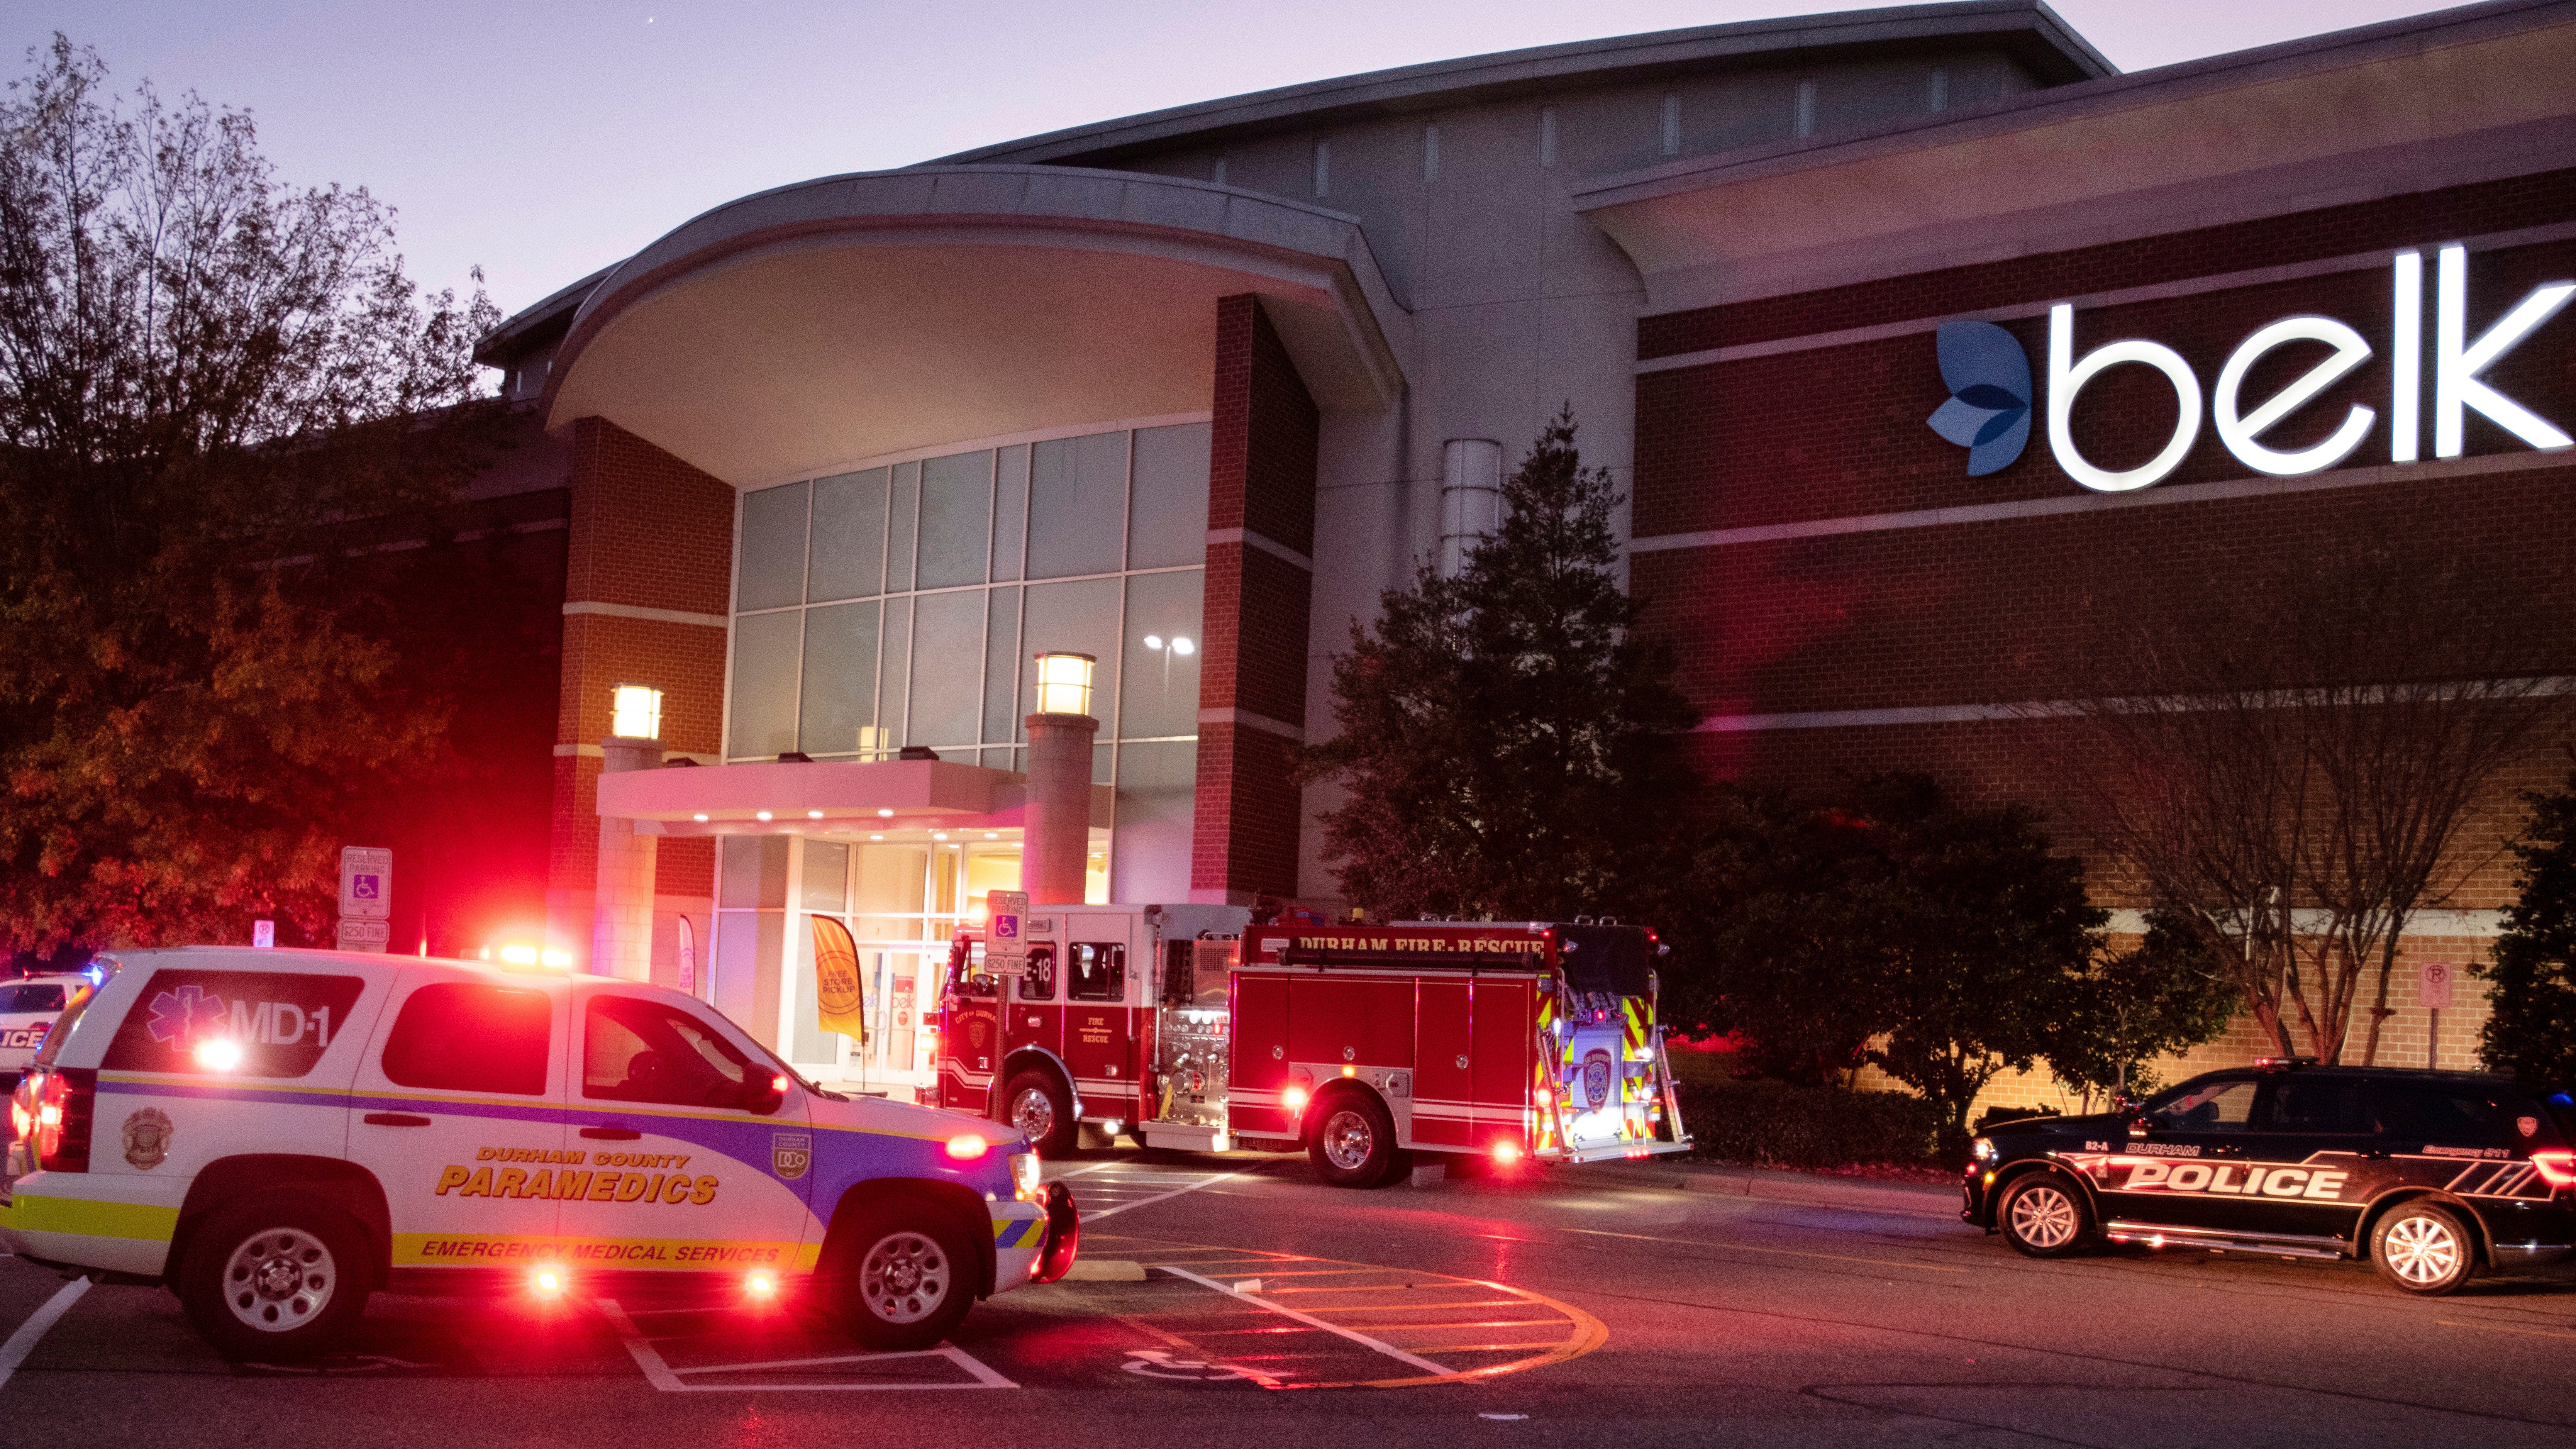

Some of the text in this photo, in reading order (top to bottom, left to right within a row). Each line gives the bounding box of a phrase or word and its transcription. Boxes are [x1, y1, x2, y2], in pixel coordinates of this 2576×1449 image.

[2049, 244, 2576, 492] belk
[347, 854, 388, 864] RESERVED
[349, 863, 385, 874] PARKING
[990, 896, 1026, 906] RESERVED
[992, 905, 1023, 915] PARKING
[344, 926, 385, 938] $250 FINE
[987, 958, 1023, 970] $250 FINE
[1023, 958, 1051, 982] E-18
[824, 977, 852, 986] STORE
[822, 985, 855, 994] PICKUP
[863, 993, 877, 1008] elk
[891, 993, 915, 1009] belk
[231, 1000, 329, 1047] MD-1
[955, 1012, 968, 1024] CITY
[976, 1010, 997, 1024] DURHA
[1088, 1017, 1104, 1025] FIRE
[0, 1031, 45, 1047] ICE
[1083, 1035, 1109, 1043] RESCUE
[2125, 1142, 2201, 1157] DURHAM
[2422, 1145, 2484, 1158] Emergency
[476, 1147, 691, 1169] DURHAM COUNTY
[435, 1165, 719, 1205] PARAMEDICS
[2123, 1163, 2348, 1199] POLICE
[422, 1241, 779, 1262] EMERGENCY MEDICAL SERVICES
